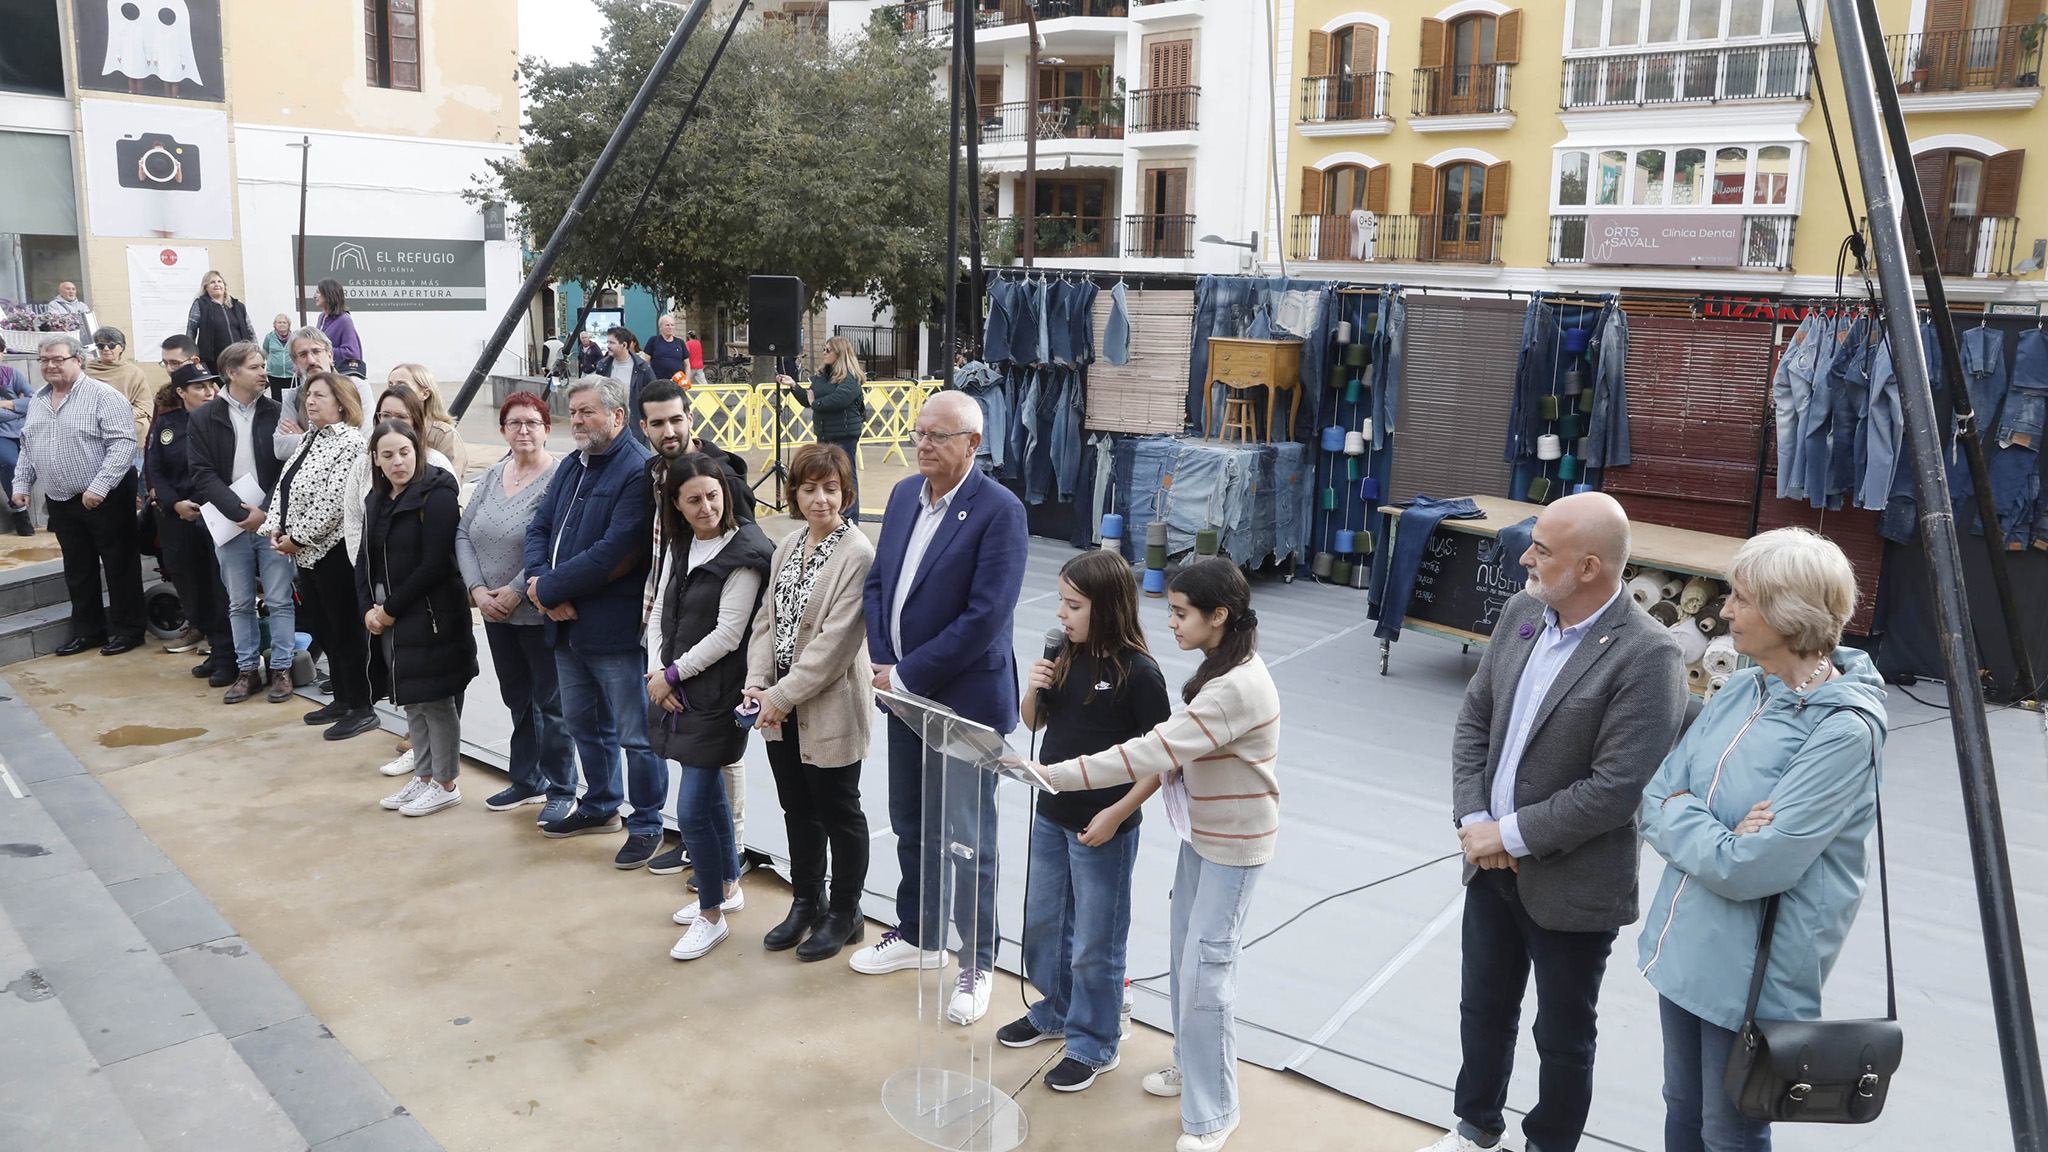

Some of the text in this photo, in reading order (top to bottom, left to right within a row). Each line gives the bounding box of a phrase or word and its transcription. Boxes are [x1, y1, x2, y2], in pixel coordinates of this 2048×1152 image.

[1604, 226, 1639, 237] ORTS
[1661, 228, 1736, 238] Clínica Dental
[1604, 237, 1660, 248] +SAVALL
[376, 251, 455, 264] EL REFUGIO
[348, 278, 440, 287] GASTROBAR Y MÁS
[343, 288, 452, 298] RÓXIMA APERTURA
